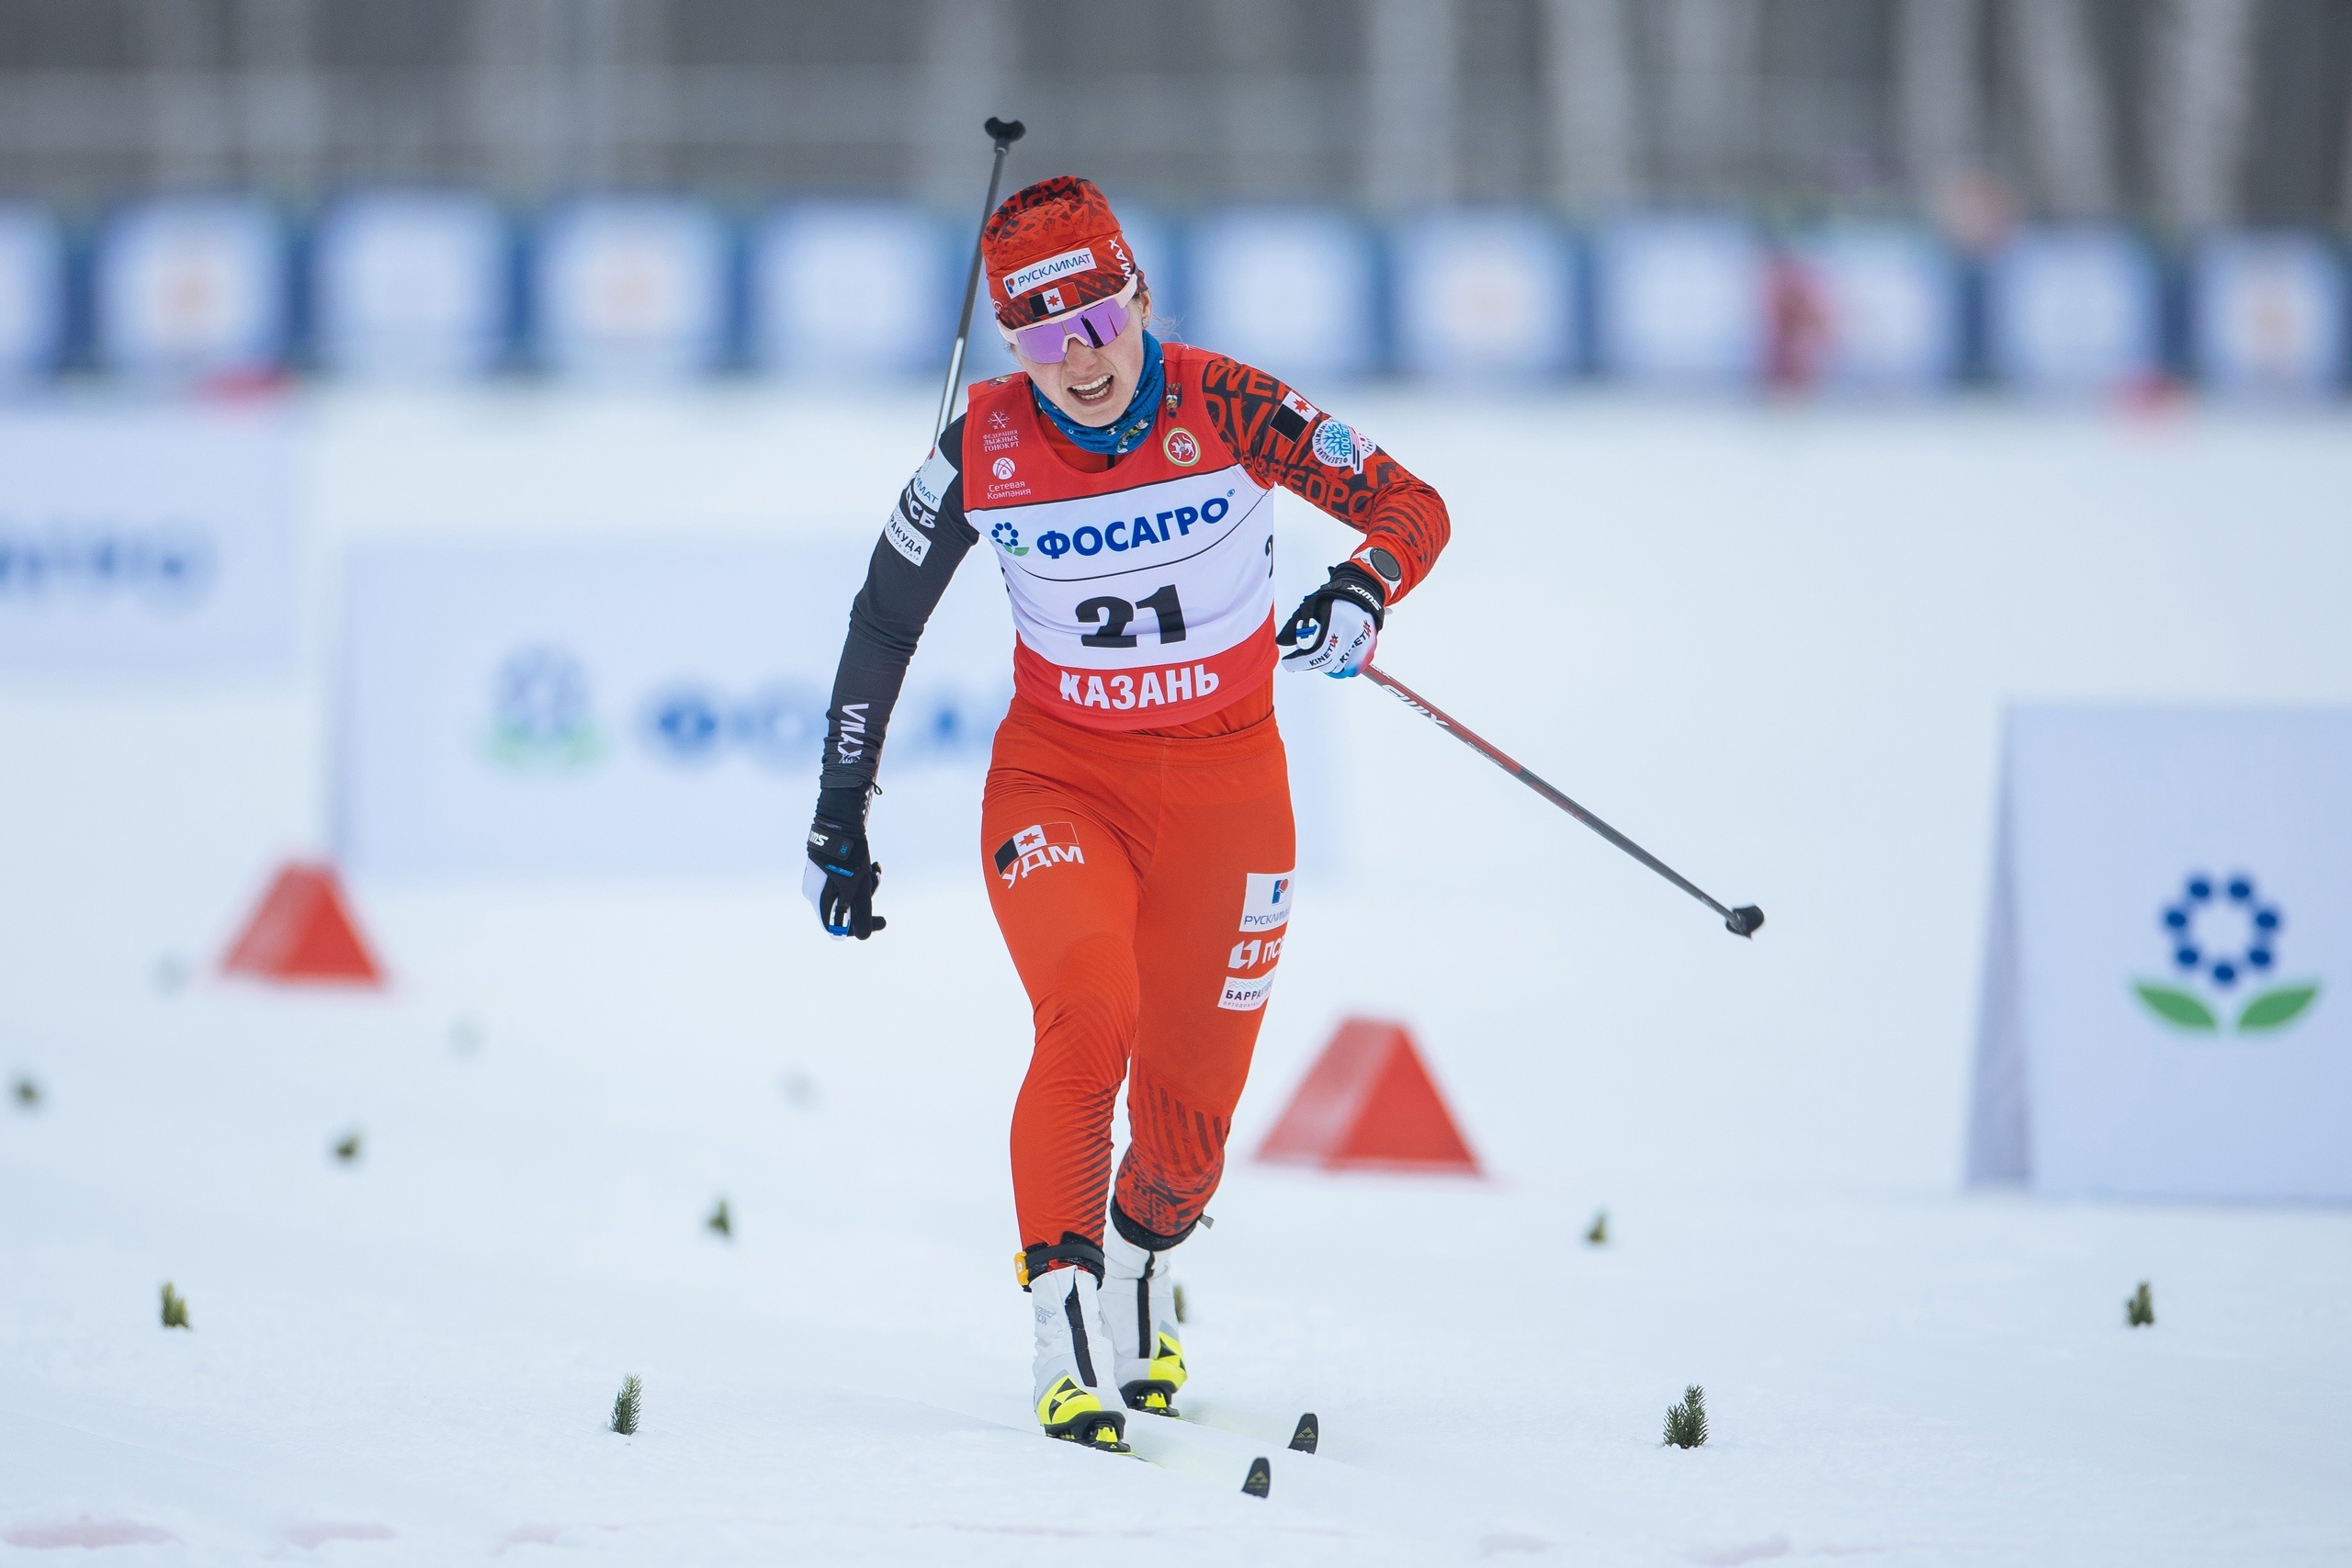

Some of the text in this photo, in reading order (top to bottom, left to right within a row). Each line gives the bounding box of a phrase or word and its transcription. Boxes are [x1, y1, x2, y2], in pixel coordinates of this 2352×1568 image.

[1108, 235, 1131, 281] MAX
[1018, 254, 1091, 287] РУСКЛИМАТ
[982, 429, 1018, 440] ФЕДЕРАЦИЯ
[983, 435, 1019, 446] ЛЫЖНЫХ
[984, 443, 1011, 452] ГОНОК
[987, 488, 1032, 500] Компания
[989, 480, 1026, 492] Сетевая
[1075, 583, 1187, 649] 21
[1059, 664, 1220, 710] КАЗАНЬ
[1001, 845, 1085, 889] УДМ
